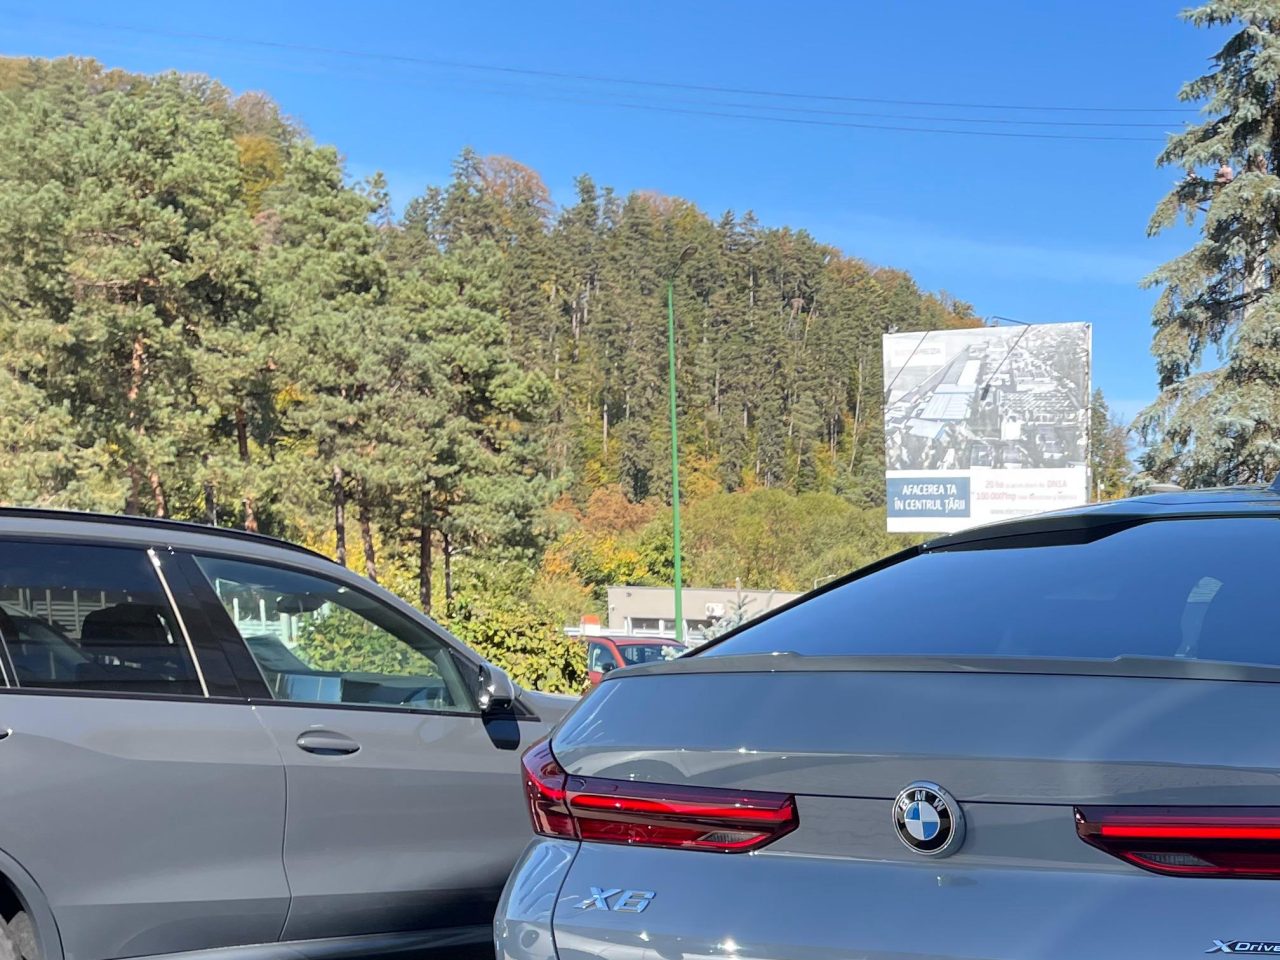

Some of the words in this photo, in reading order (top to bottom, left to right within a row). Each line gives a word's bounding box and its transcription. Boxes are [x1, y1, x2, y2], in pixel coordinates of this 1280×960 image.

[902, 484, 945, 496] AFACEREA
[946, 484, 957, 496] TA
[894, 496, 904, 511] ÎN
[905, 499, 943, 511] CENTRUL
[898, 790, 946, 812] BMW
[573, 887, 656, 913] X6
